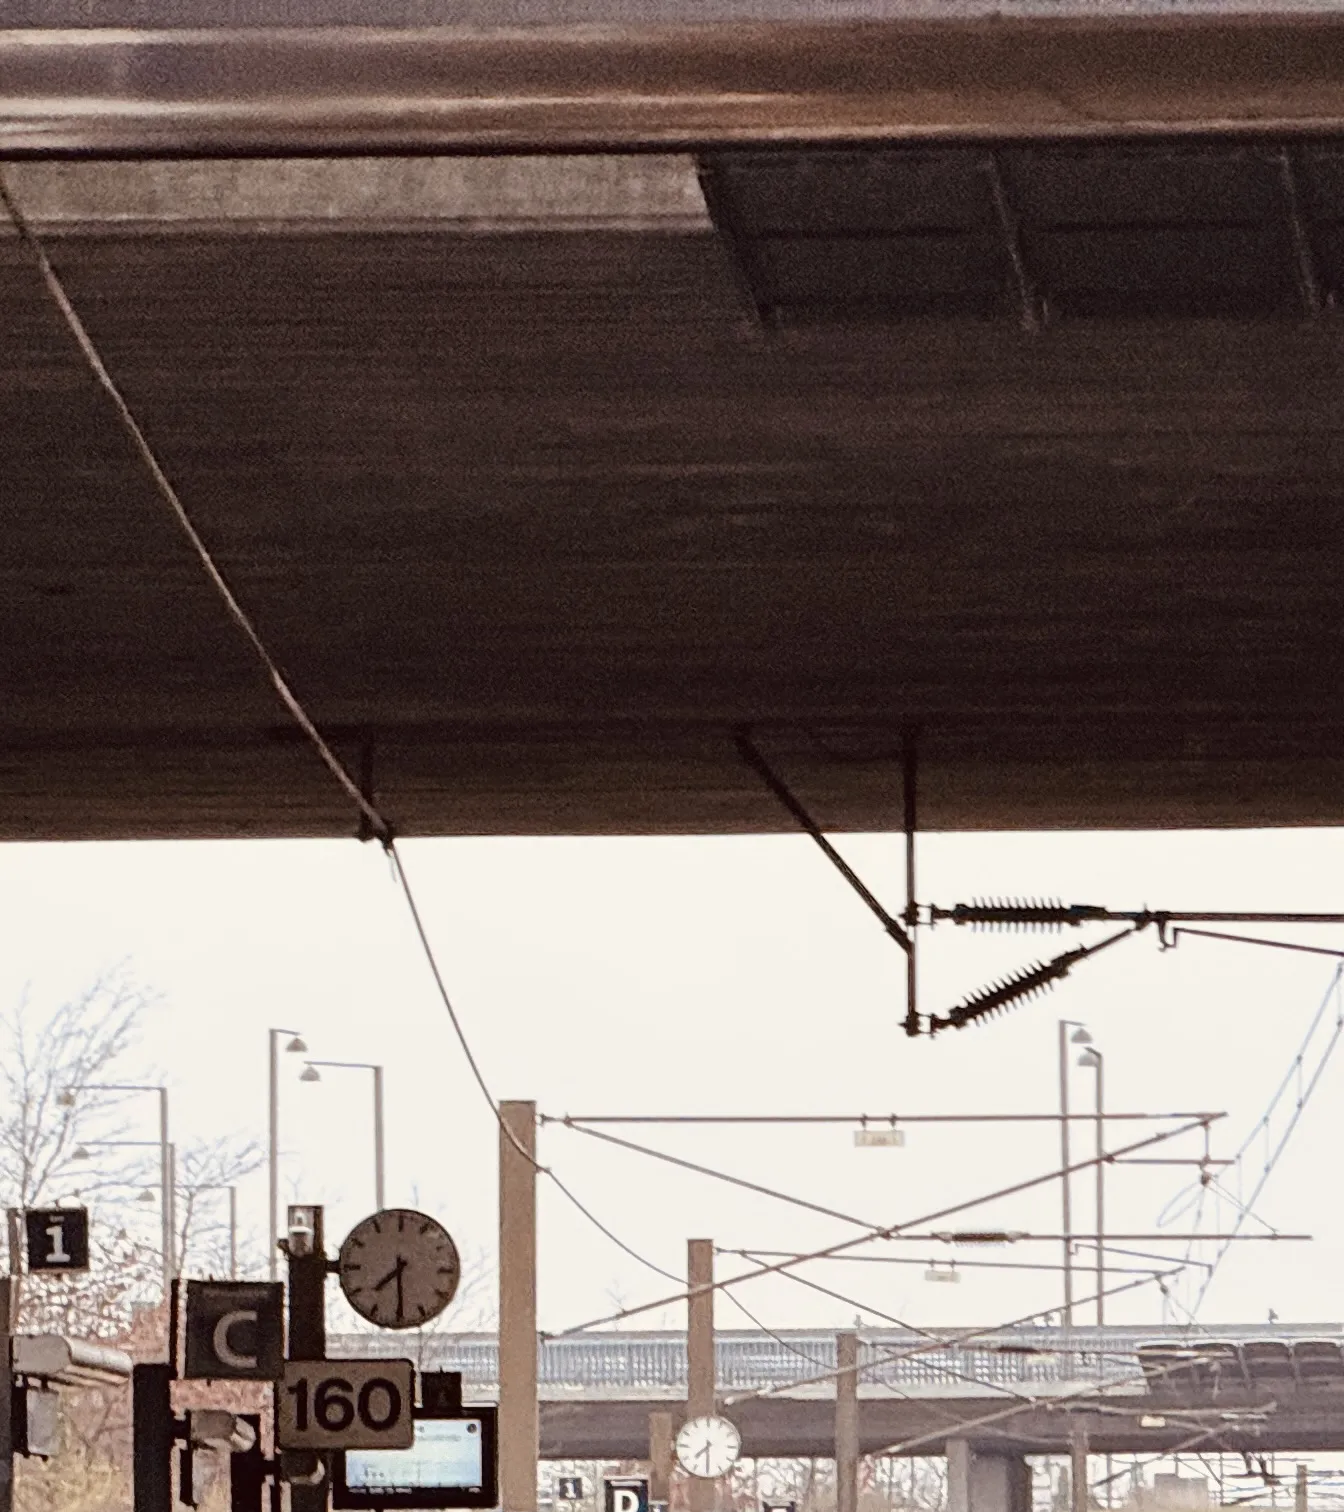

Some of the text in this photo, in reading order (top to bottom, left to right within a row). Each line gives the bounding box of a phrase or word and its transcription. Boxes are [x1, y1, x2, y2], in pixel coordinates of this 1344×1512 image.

[46, 1226, 70, 1262] 1
[213, 1310, 257, 1369] C
[287, 1377, 401, 1432] 160
[564, 1482, 577, 1498] 1
